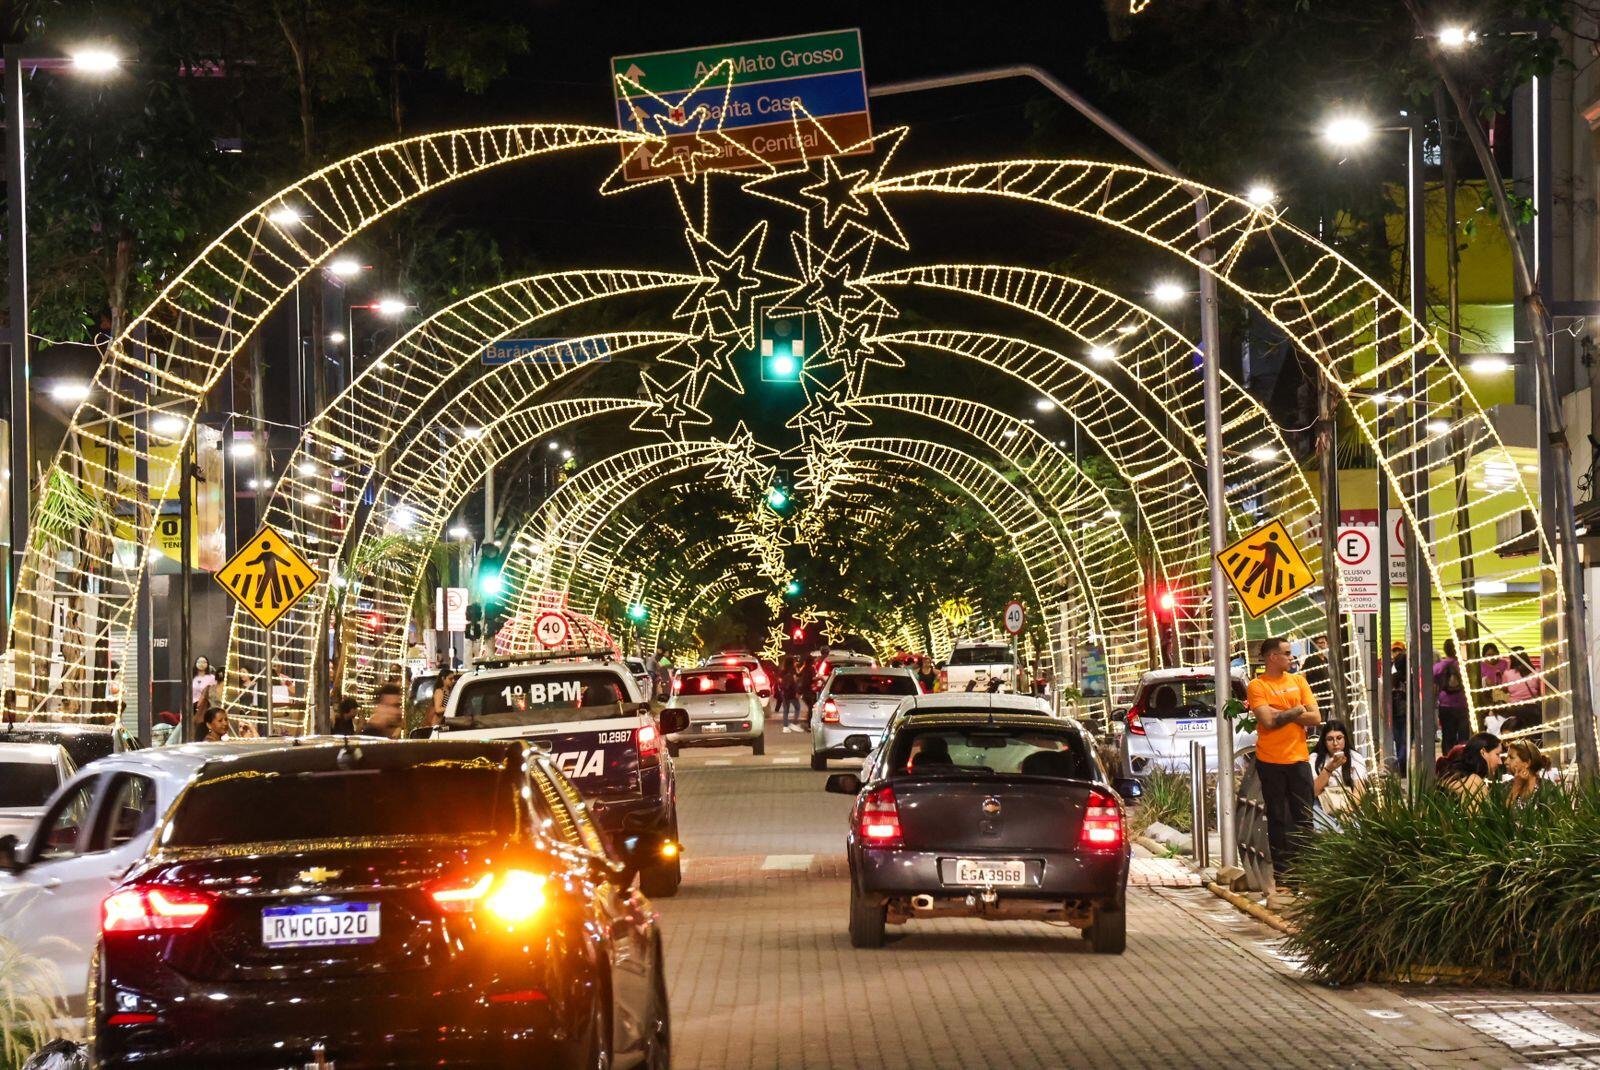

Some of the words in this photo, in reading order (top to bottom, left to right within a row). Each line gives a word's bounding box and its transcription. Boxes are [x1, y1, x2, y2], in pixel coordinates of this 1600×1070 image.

[694, 61, 726, 79] Av.
[731, 56, 776, 75] Mato
[780, 48, 844, 69] Grosso
[698, 101, 752, 121] Santa
[757, 96, 802, 114] Casa
[752, 130, 818, 153] Central
[1347, 538, 1358, 557] E
[1008, 610, 1020, 622] 40
[542, 621, 560, 634] 40
[530, 680, 582, 704] BPM
[598, 730, 632, 745] 10.2987
[988, 870, 1021, 882] 3968
